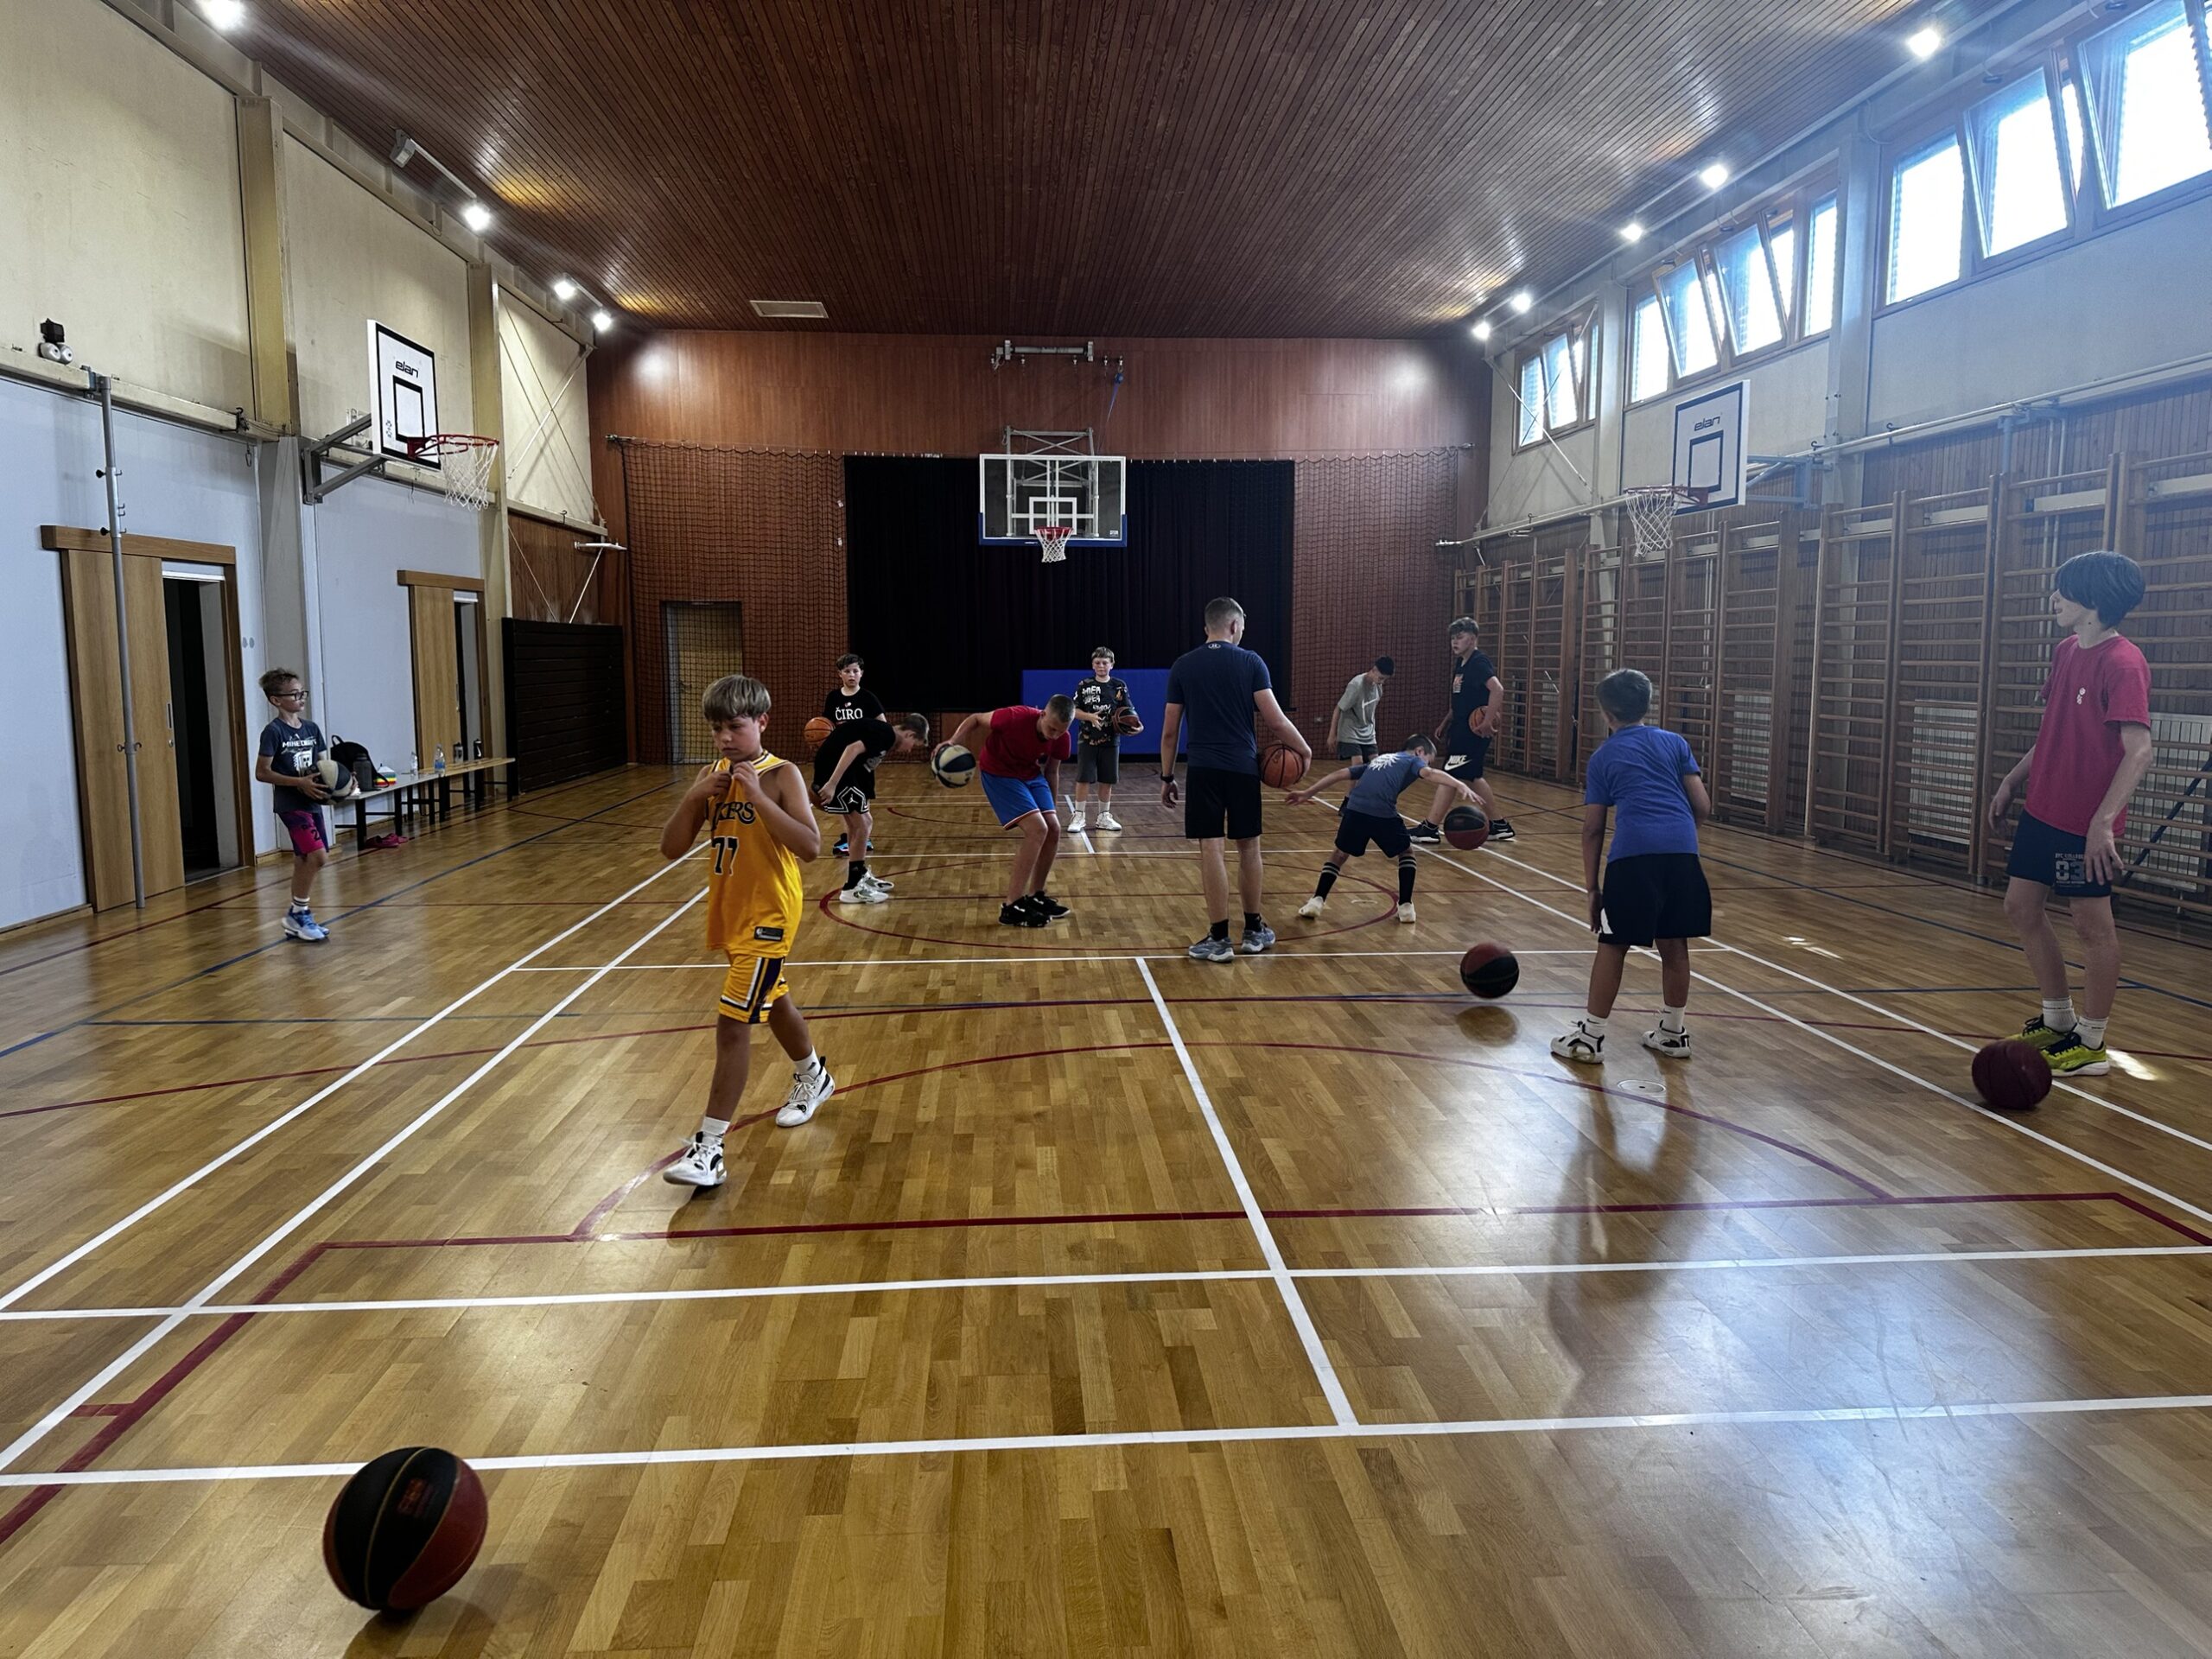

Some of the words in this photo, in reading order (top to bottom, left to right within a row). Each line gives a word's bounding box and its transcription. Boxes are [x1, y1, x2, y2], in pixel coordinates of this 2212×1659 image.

[395, 360, 419, 378] elan
[1694, 416, 1720, 431] elan
[835, 706, 863, 721] ČIRO
[1448, 754, 1467, 764] NIKE
[714, 801, 756, 825] KERS
[711, 836, 739, 876] 77
[2056, 861, 2085, 880] 03
